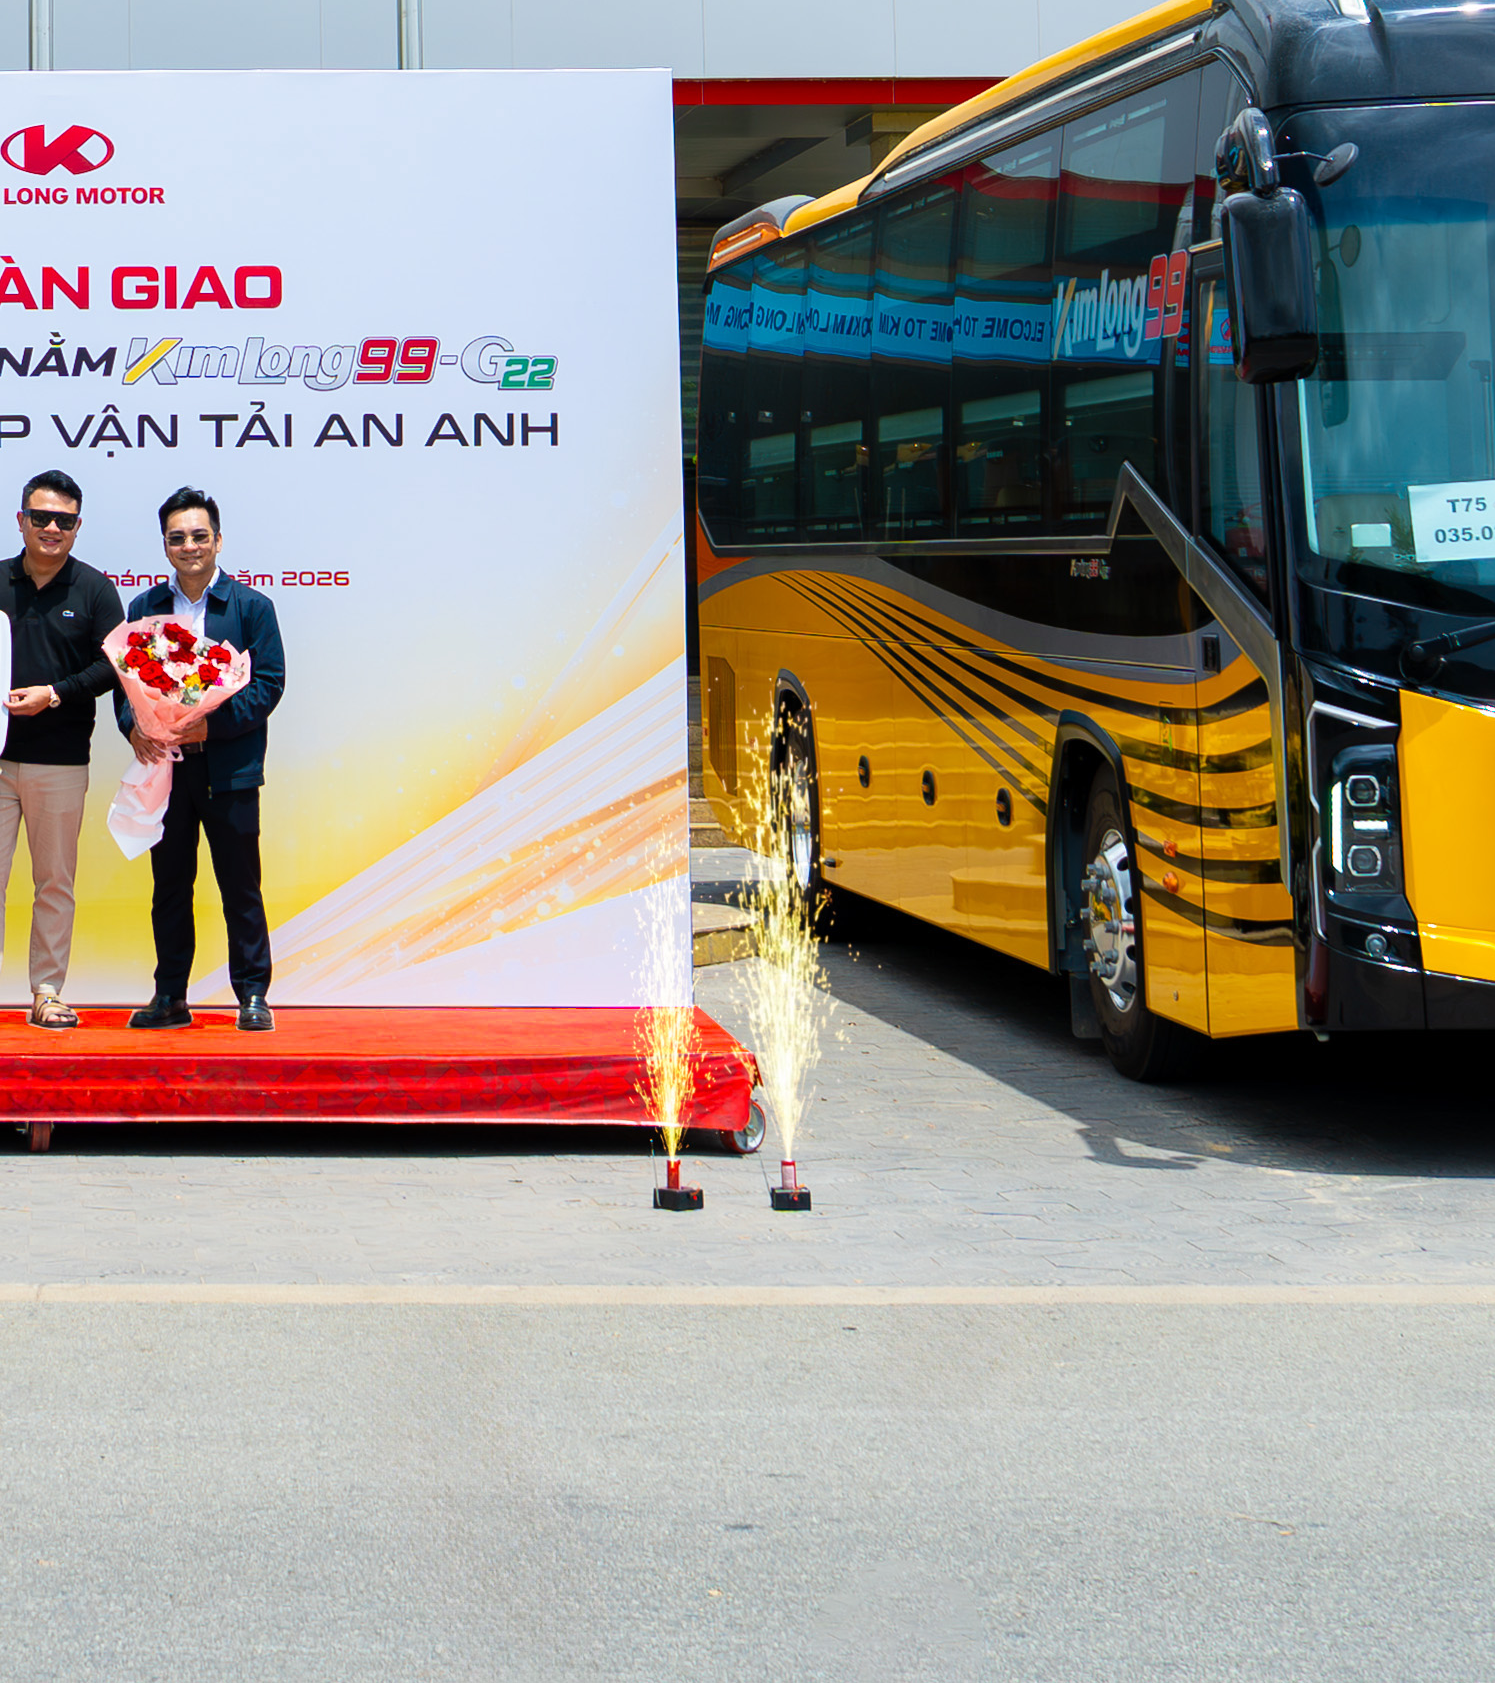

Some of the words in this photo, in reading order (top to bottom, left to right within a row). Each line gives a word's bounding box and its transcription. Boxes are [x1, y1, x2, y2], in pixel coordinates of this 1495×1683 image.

[3, 187, 69, 206] LONG
[75, 187, 166, 206] MOTOR
[111, 265, 283, 311] GIAO
[51, 404, 179, 458] VẬN
[199, 400, 292, 448] TẢI
[313, 413, 404, 448] AN
[424, 412, 558, 447] ANH
[1446, 496, 1487, 513] T75
[227, 568, 274, 587] ăm
[281, 570, 350, 587] 2026
